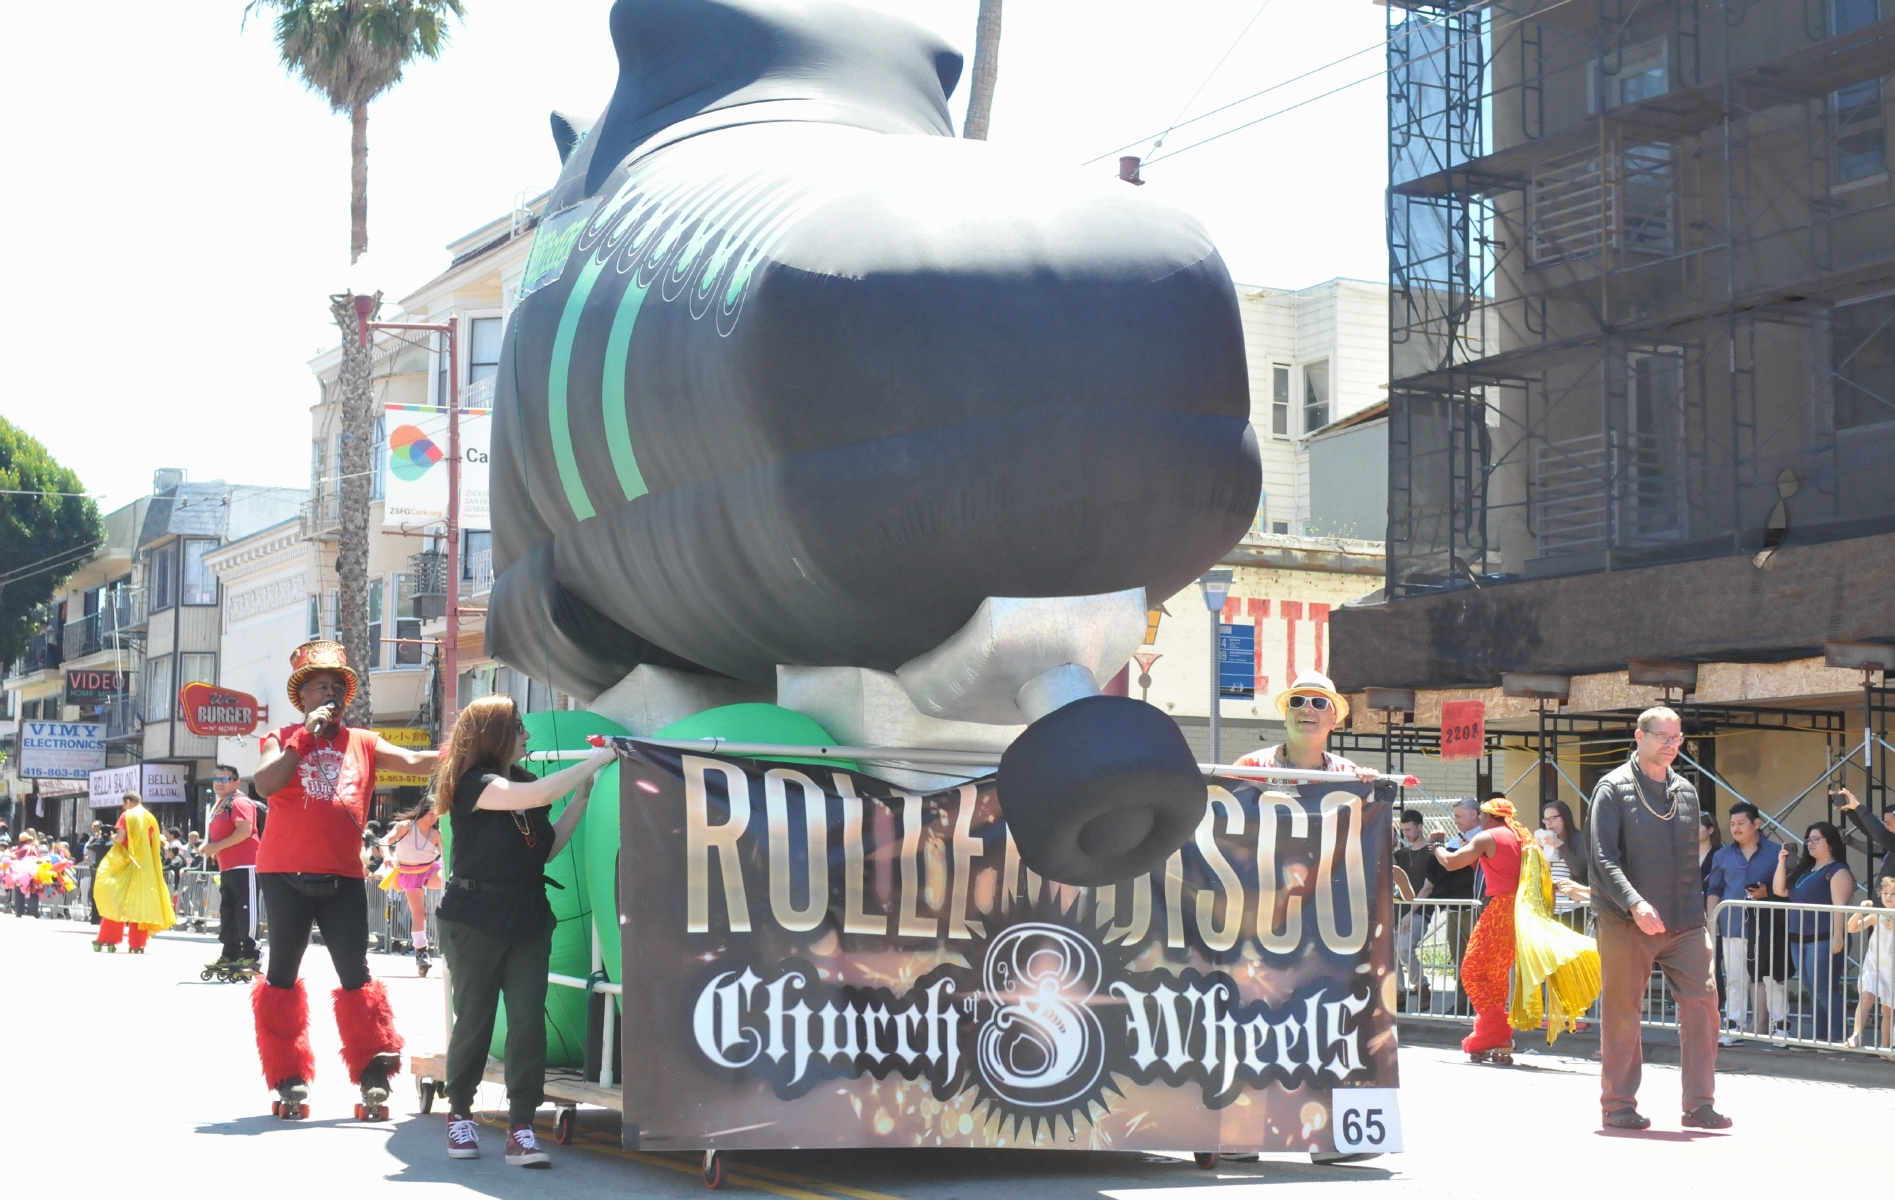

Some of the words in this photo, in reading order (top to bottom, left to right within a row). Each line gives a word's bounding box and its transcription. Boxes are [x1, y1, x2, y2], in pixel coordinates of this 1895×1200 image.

[466, 447, 488, 463] Ca
[390, 507, 442, 517] ZSFGCare.org
[69, 672, 125, 690] VIDEO
[197, 706, 252, 724] BURGER
[29, 723, 100, 737] VIMY
[1446, 723, 1479, 743] 2208
[23, 738, 104, 749] ELECTRONICS
[24, 768, 90, 777] 415-863-83
[148, 774, 178, 785] BELLA
[375, 775, 428, 783] 15-863-5710
[93, 775, 112, 796] BELLA
[693, 965, 961, 1087] Church
[963, 989, 982, 1024] of
[1108, 981, 1371, 1097] Wheels
[1342, 1108, 1386, 1146] 65
